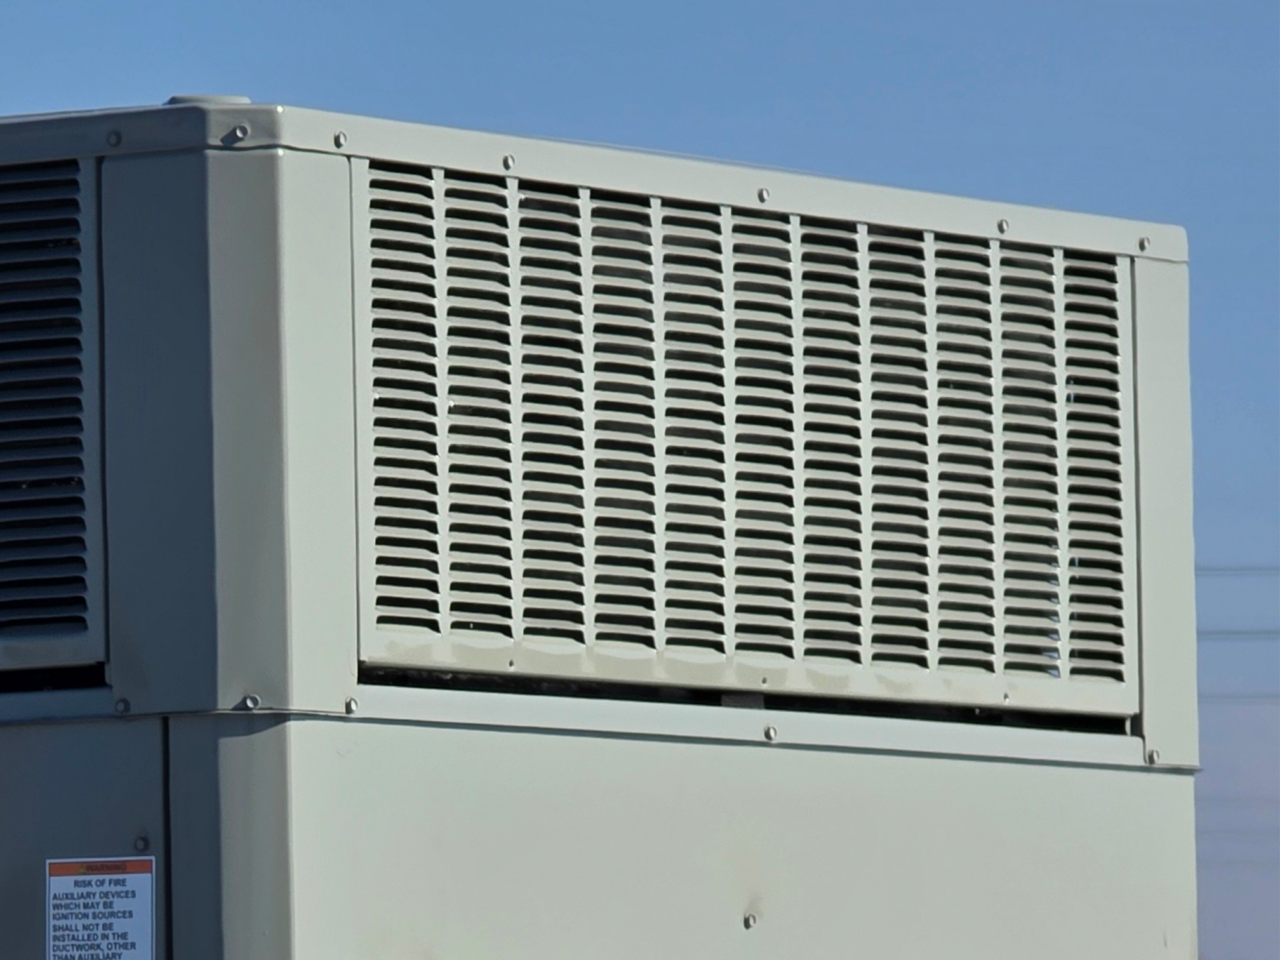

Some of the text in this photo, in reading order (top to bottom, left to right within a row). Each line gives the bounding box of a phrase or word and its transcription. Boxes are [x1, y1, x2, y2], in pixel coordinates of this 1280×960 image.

[95, 879, 105, 887] OF
[109, 879, 127, 887] FIRE
[53, 891, 136, 900] AUXILIARY DEVICES
[53, 901, 114, 910] WHICH MAY BE
[53, 911, 133, 921] IGNITION SOURCES
[53, 923, 114, 932] SHALL NOT BE
[53, 933, 98, 942] INSTALLED
[112, 932, 128, 940] THE
[53, 942, 136, 952] DUCTWORK, OTHER
[78, 953, 122, 960] AUXILIARY
